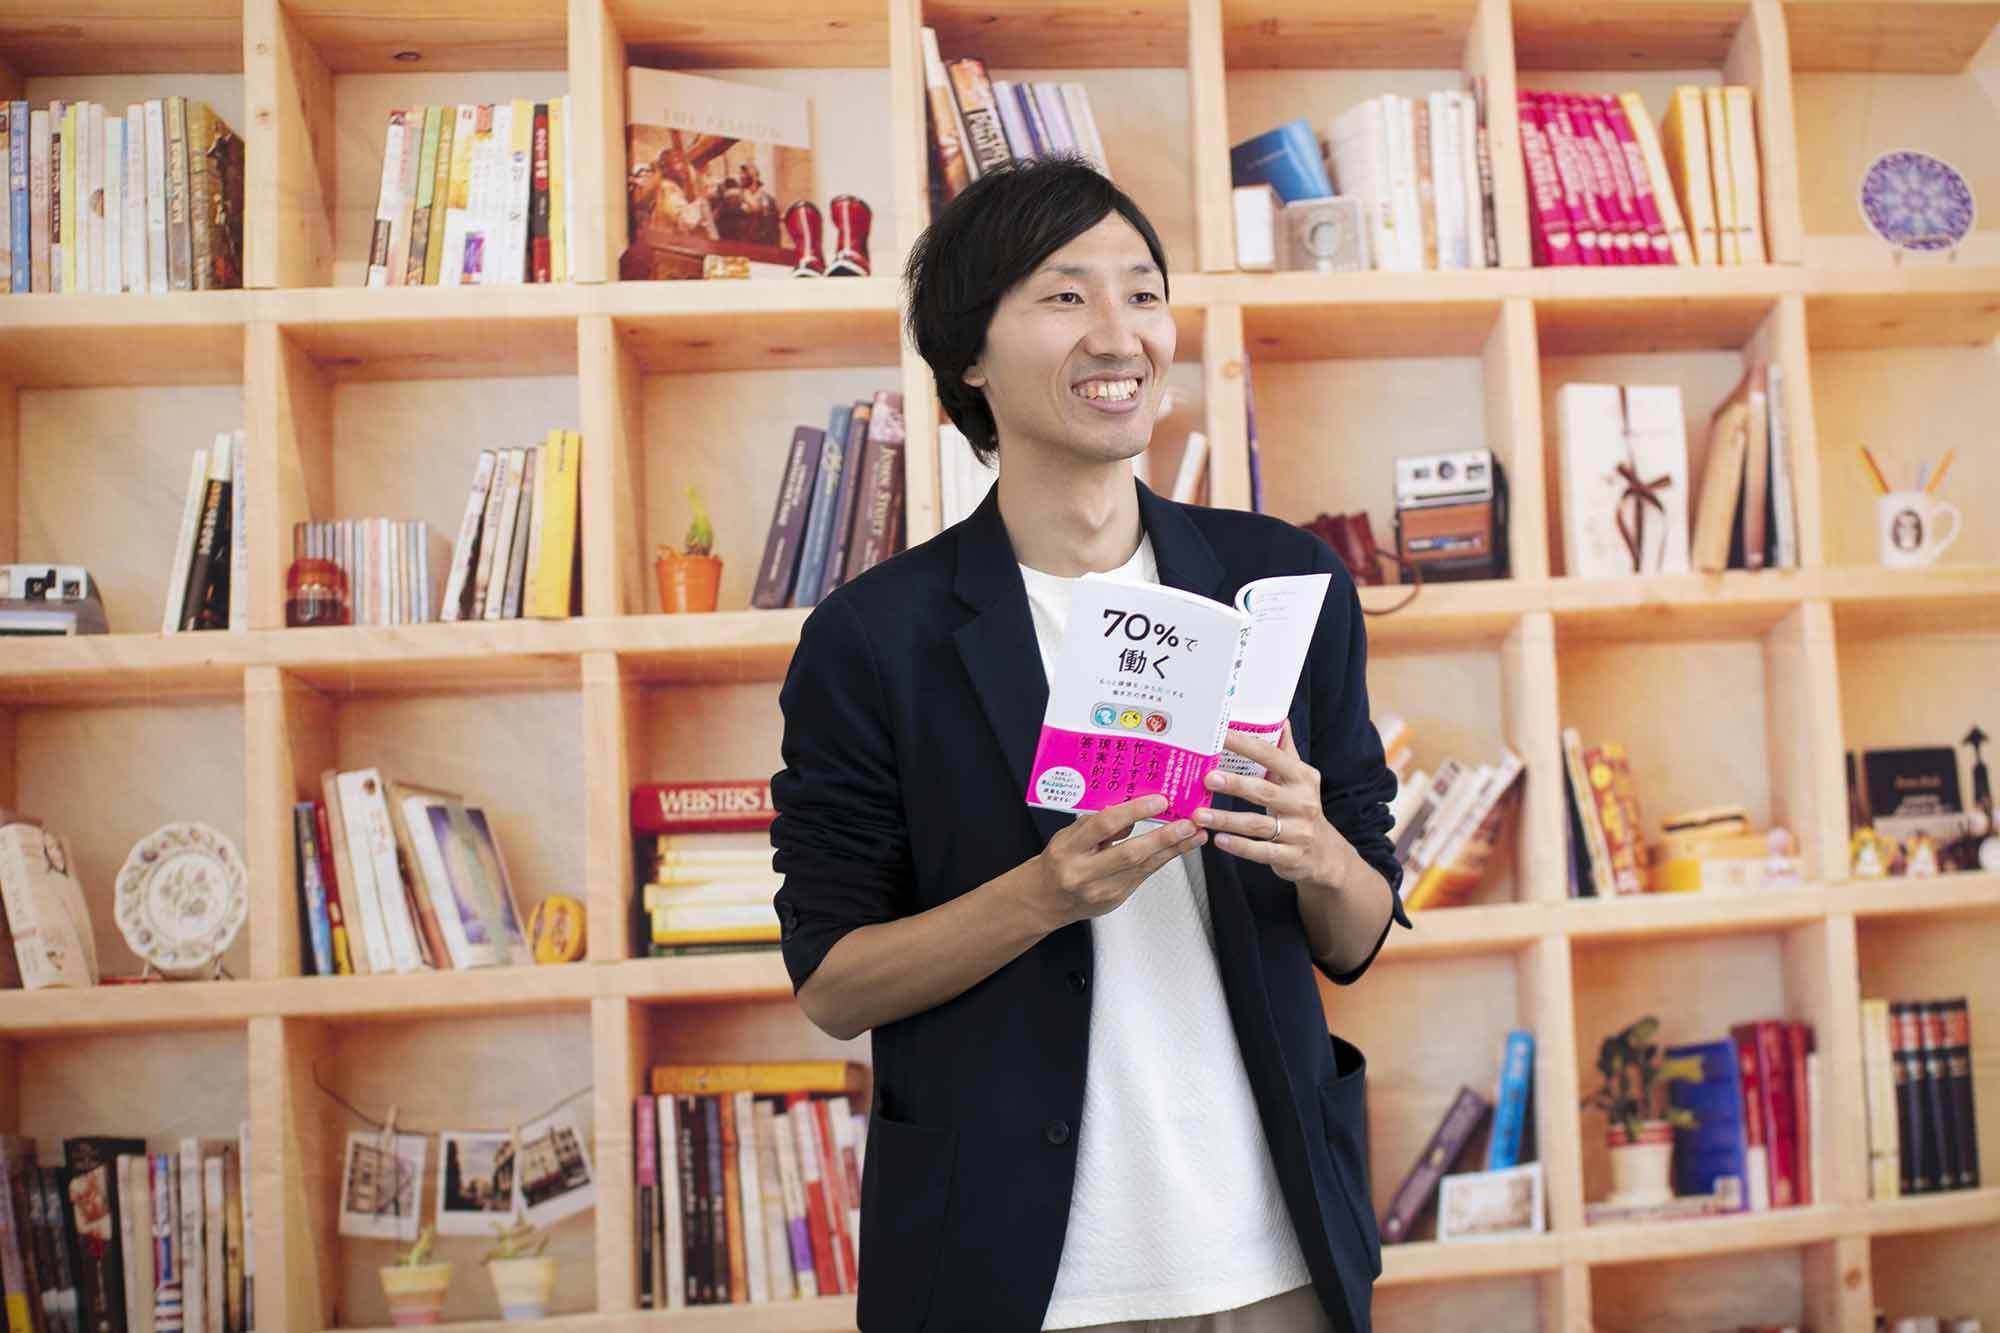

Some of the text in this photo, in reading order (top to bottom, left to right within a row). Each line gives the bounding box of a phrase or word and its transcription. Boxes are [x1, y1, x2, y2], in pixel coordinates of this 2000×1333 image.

[1103, 608, 1199, 653] 70%で
[1118, 647, 1170, 680] 働く
[1080, 736, 1093, 762] 答え
[1090, 738, 1111, 790] 現実的な
[1106, 739, 1128, 792] 私たちの
[1145, 746, 1163, 782] これが
